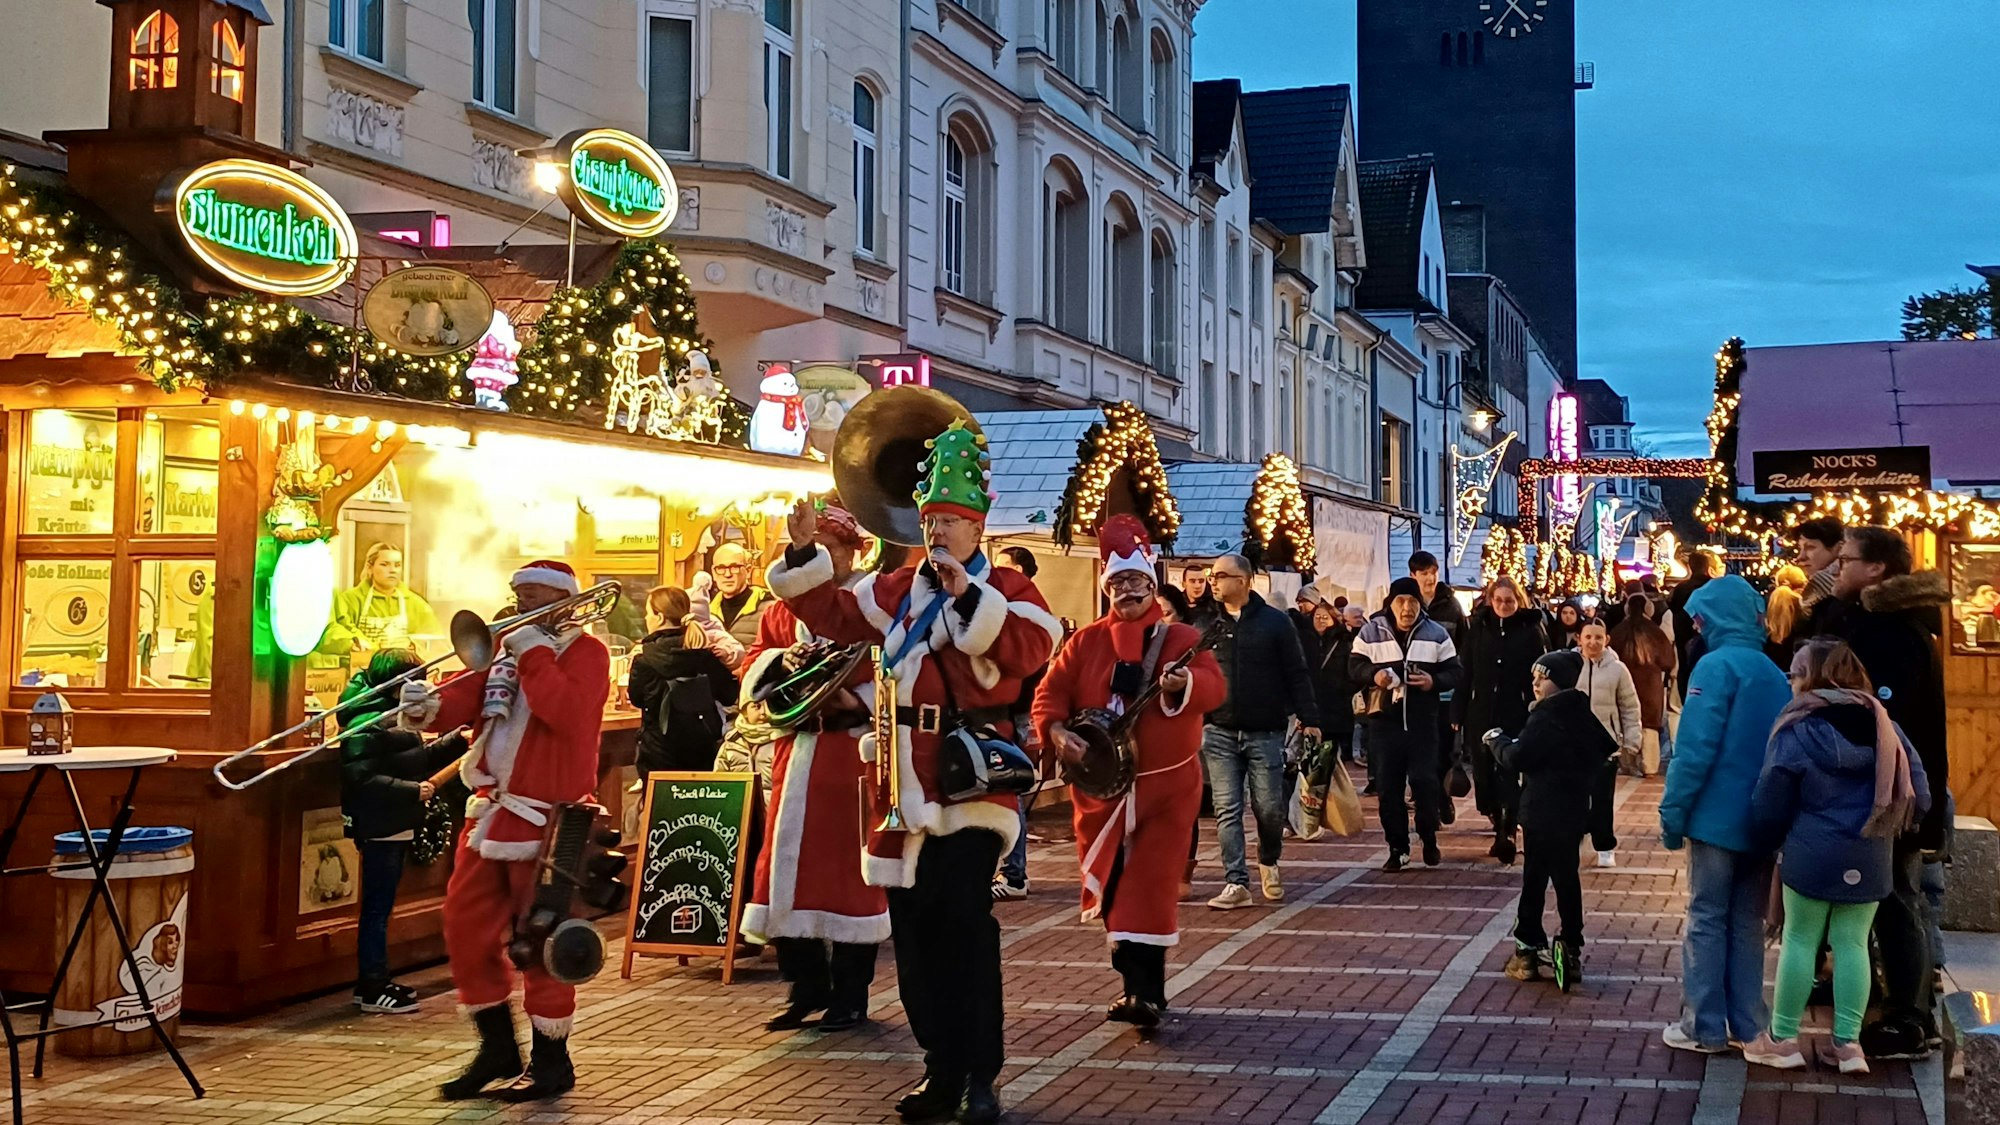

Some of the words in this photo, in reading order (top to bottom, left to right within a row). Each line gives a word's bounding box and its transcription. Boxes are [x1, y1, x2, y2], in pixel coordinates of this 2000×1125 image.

[186, 187, 338, 266] Blumenkohl
[1768, 471, 1920, 490] Reibekuchenhütte
[37, 516, 93, 533] Kräute
[649, 811, 740, 857] Blumenkohl
[644, 840, 734, 893] Champignons
